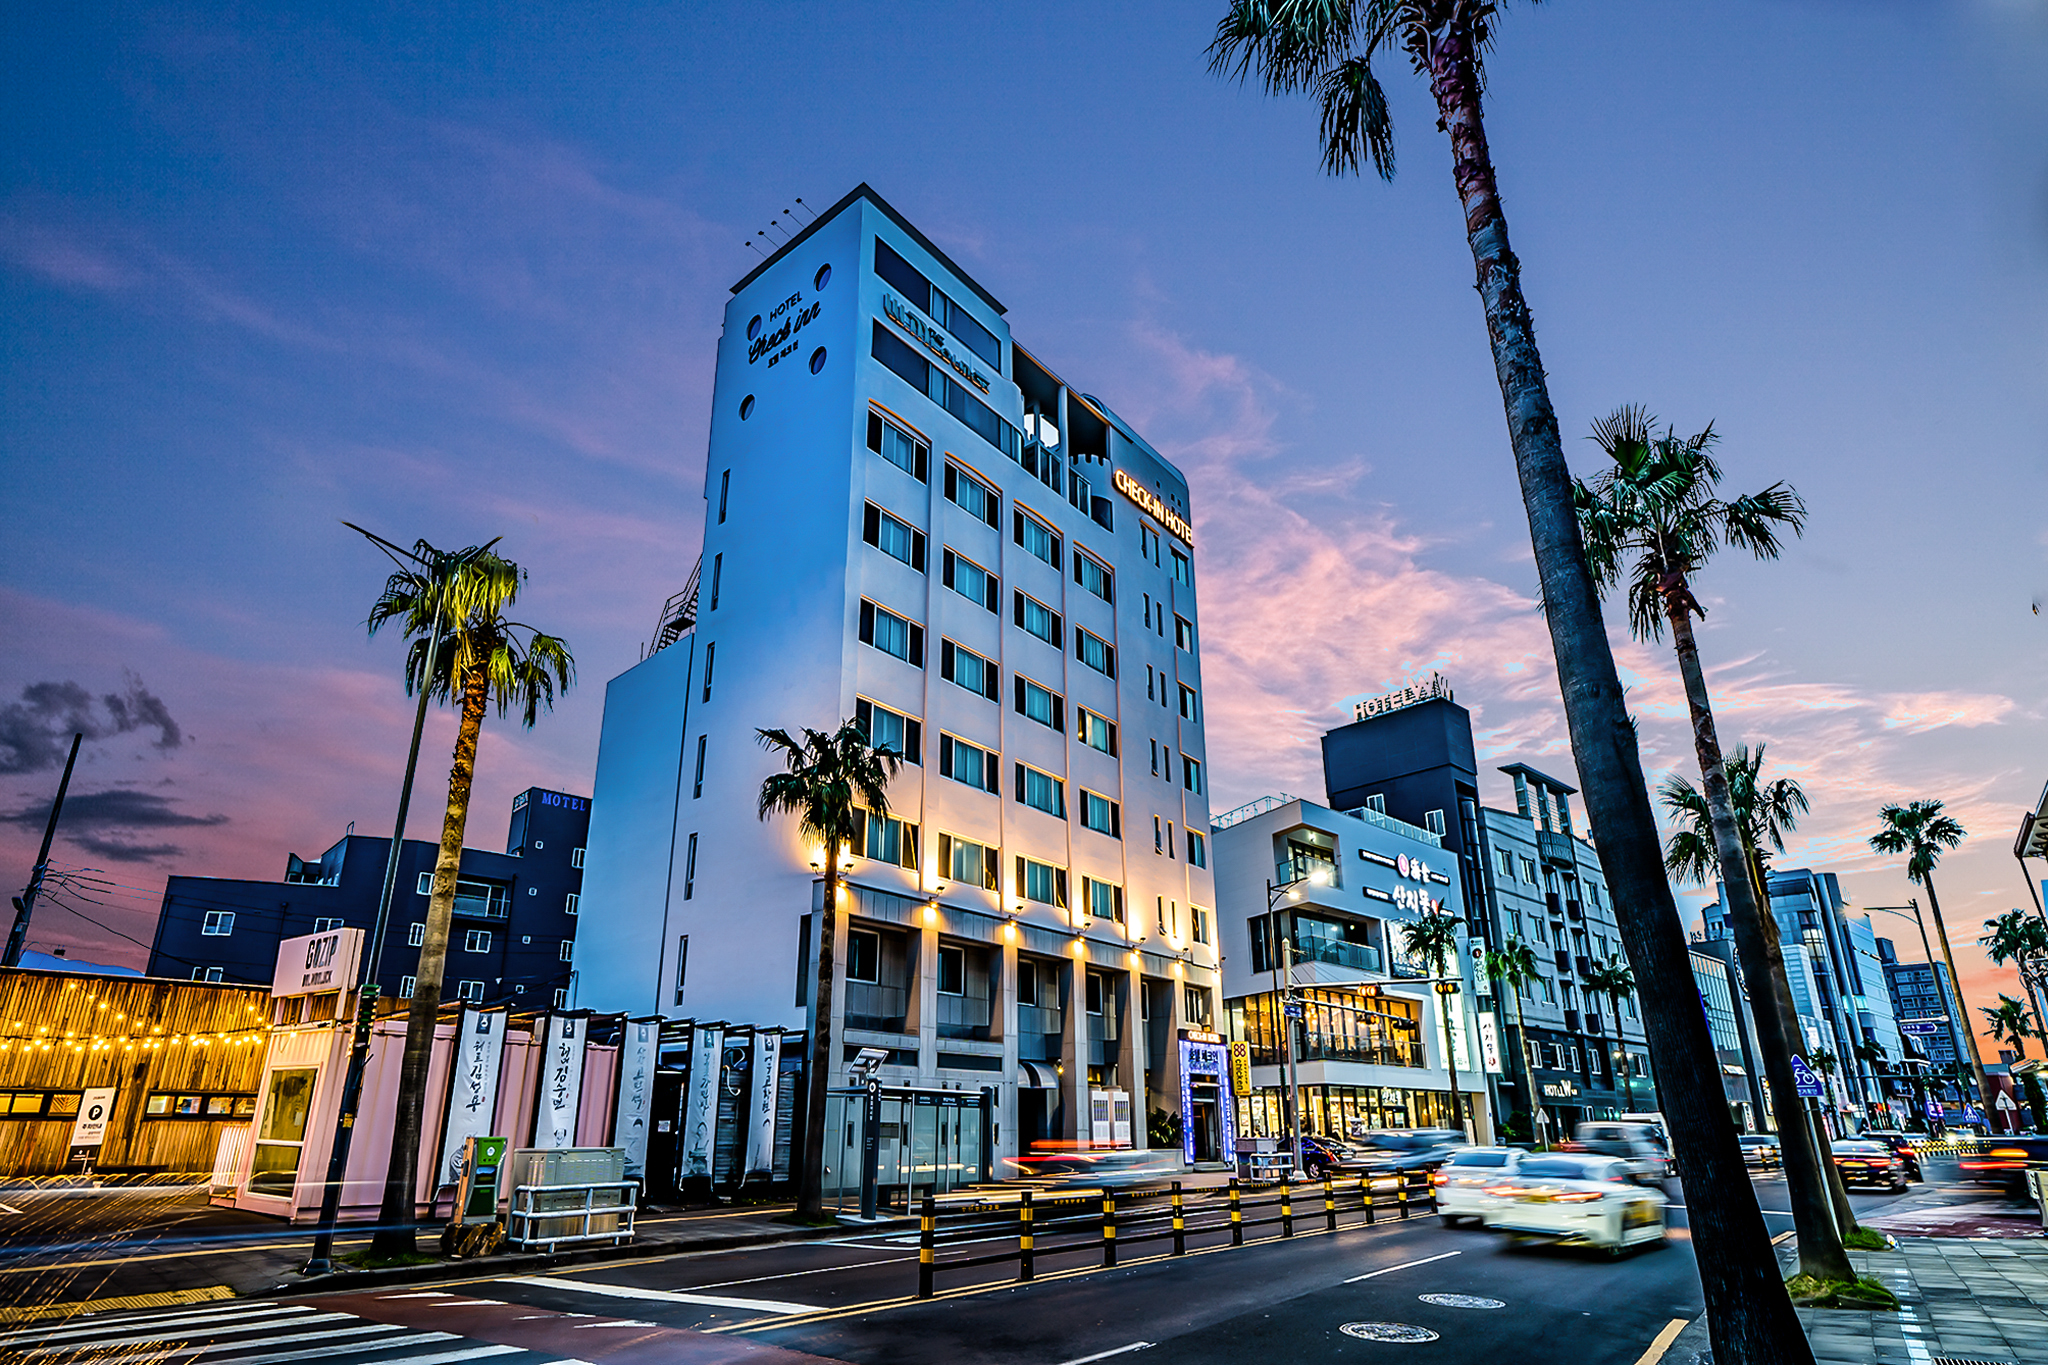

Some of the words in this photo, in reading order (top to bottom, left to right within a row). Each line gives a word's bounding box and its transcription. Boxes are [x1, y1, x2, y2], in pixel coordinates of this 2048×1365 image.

[769, 291, 802, 322] HOTEL
[1115, 468, 1165, 523] CHECK-IN
[1353, 687, 1414, 720] HOTEL
[541, 792, 587, 811] MOTEL
[305, 934, 339, 970] GOZIP
[1235, 1058, 1244, 1091] chicken
